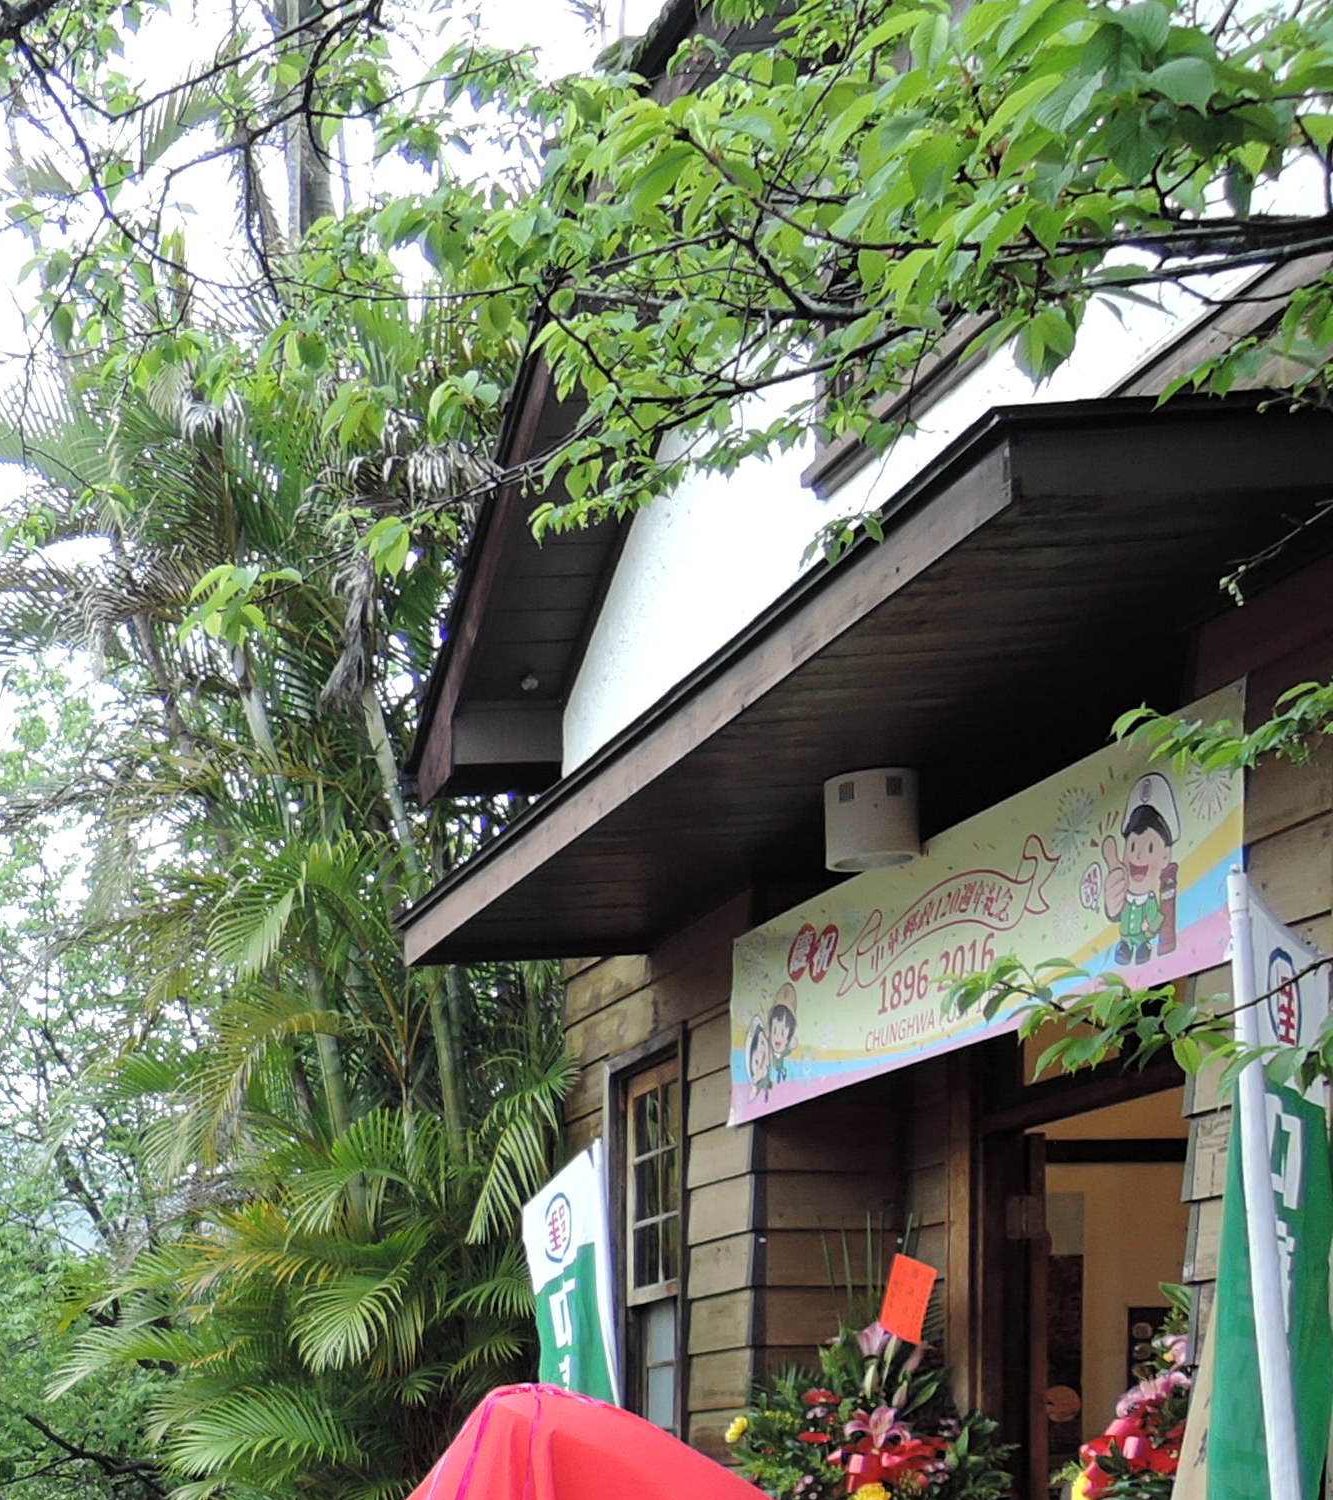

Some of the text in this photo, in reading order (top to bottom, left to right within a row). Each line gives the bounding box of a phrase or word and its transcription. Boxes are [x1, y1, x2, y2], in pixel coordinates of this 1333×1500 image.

[870, 879, 1014, 973] 中華郵政120週年紀念
[790, 929, 837, 977] 慶祝
[878, 957, 930, 1016] 1896
[865, 1008, 935, 1053] CHUNGHWA
